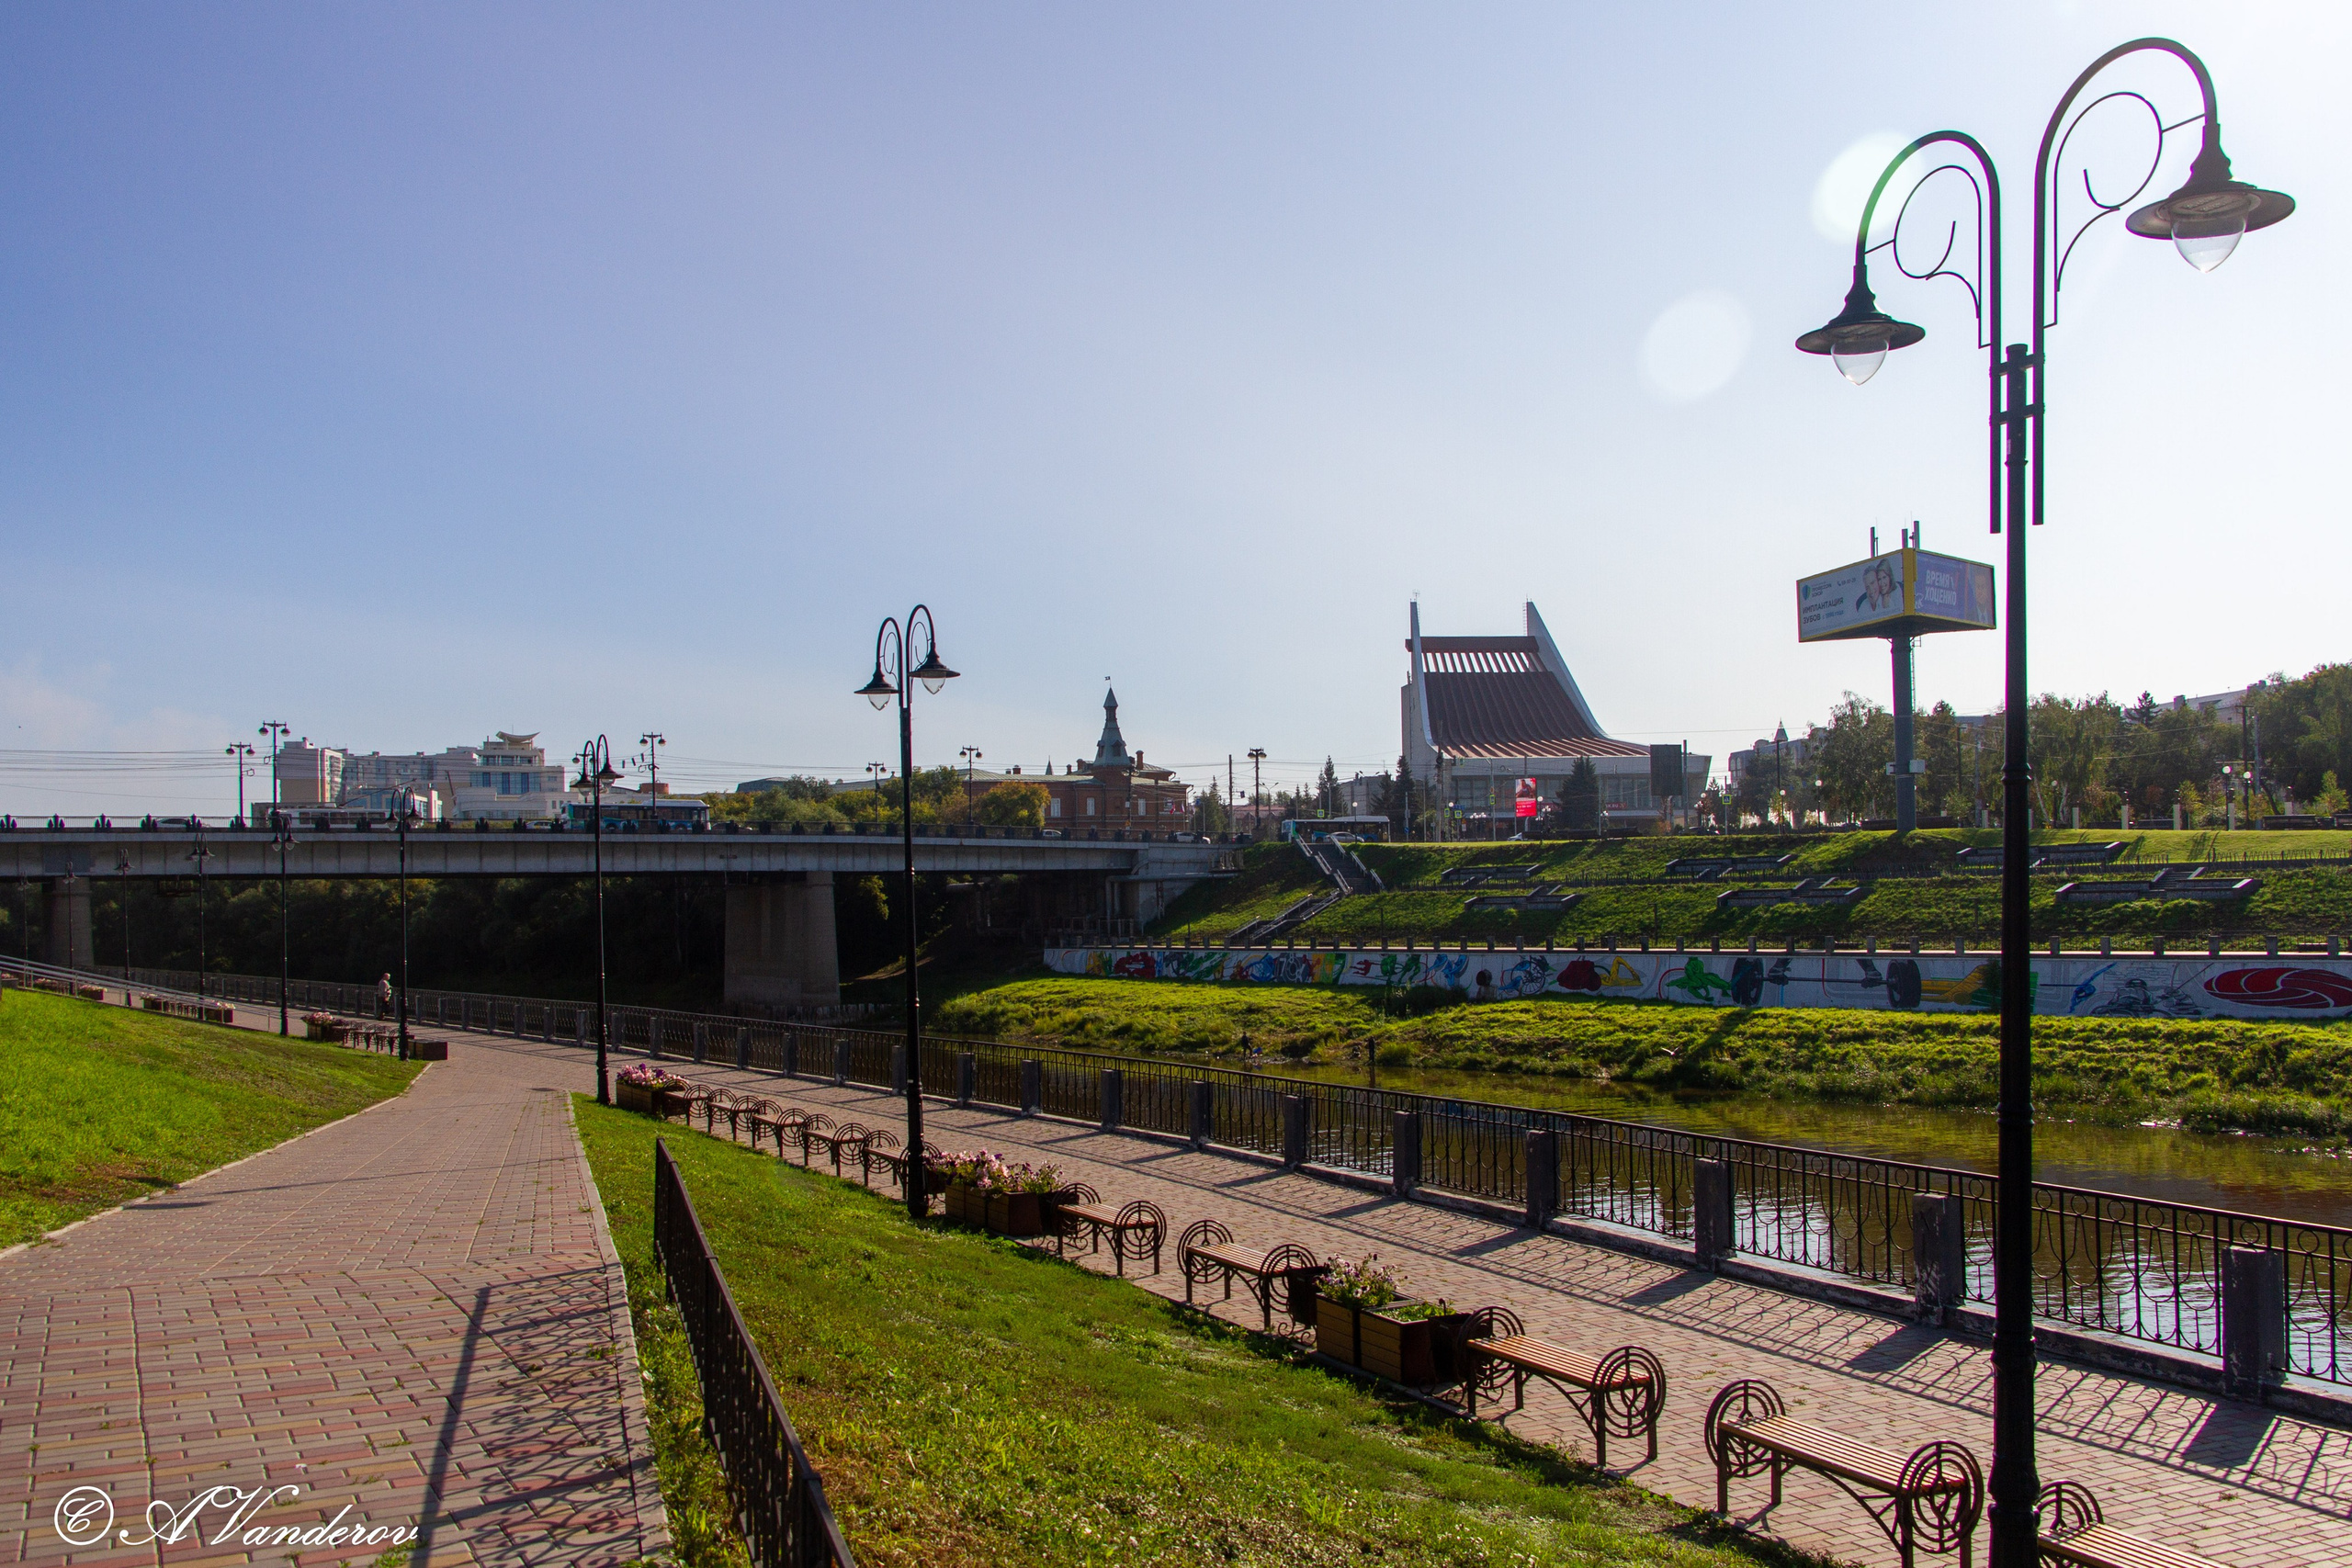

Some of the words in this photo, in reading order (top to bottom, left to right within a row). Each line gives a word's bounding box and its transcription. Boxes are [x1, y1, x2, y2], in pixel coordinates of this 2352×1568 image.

[1926, 570, 1950, 588] ВРЕМЯ
[1925, 586, 1957, 606] ХОЦЕНКО
[1803, 597, 1843, 615] ИМПЛАНТАЦИЯ
[1803, 614, 1820, 625] ЗУБОВ
